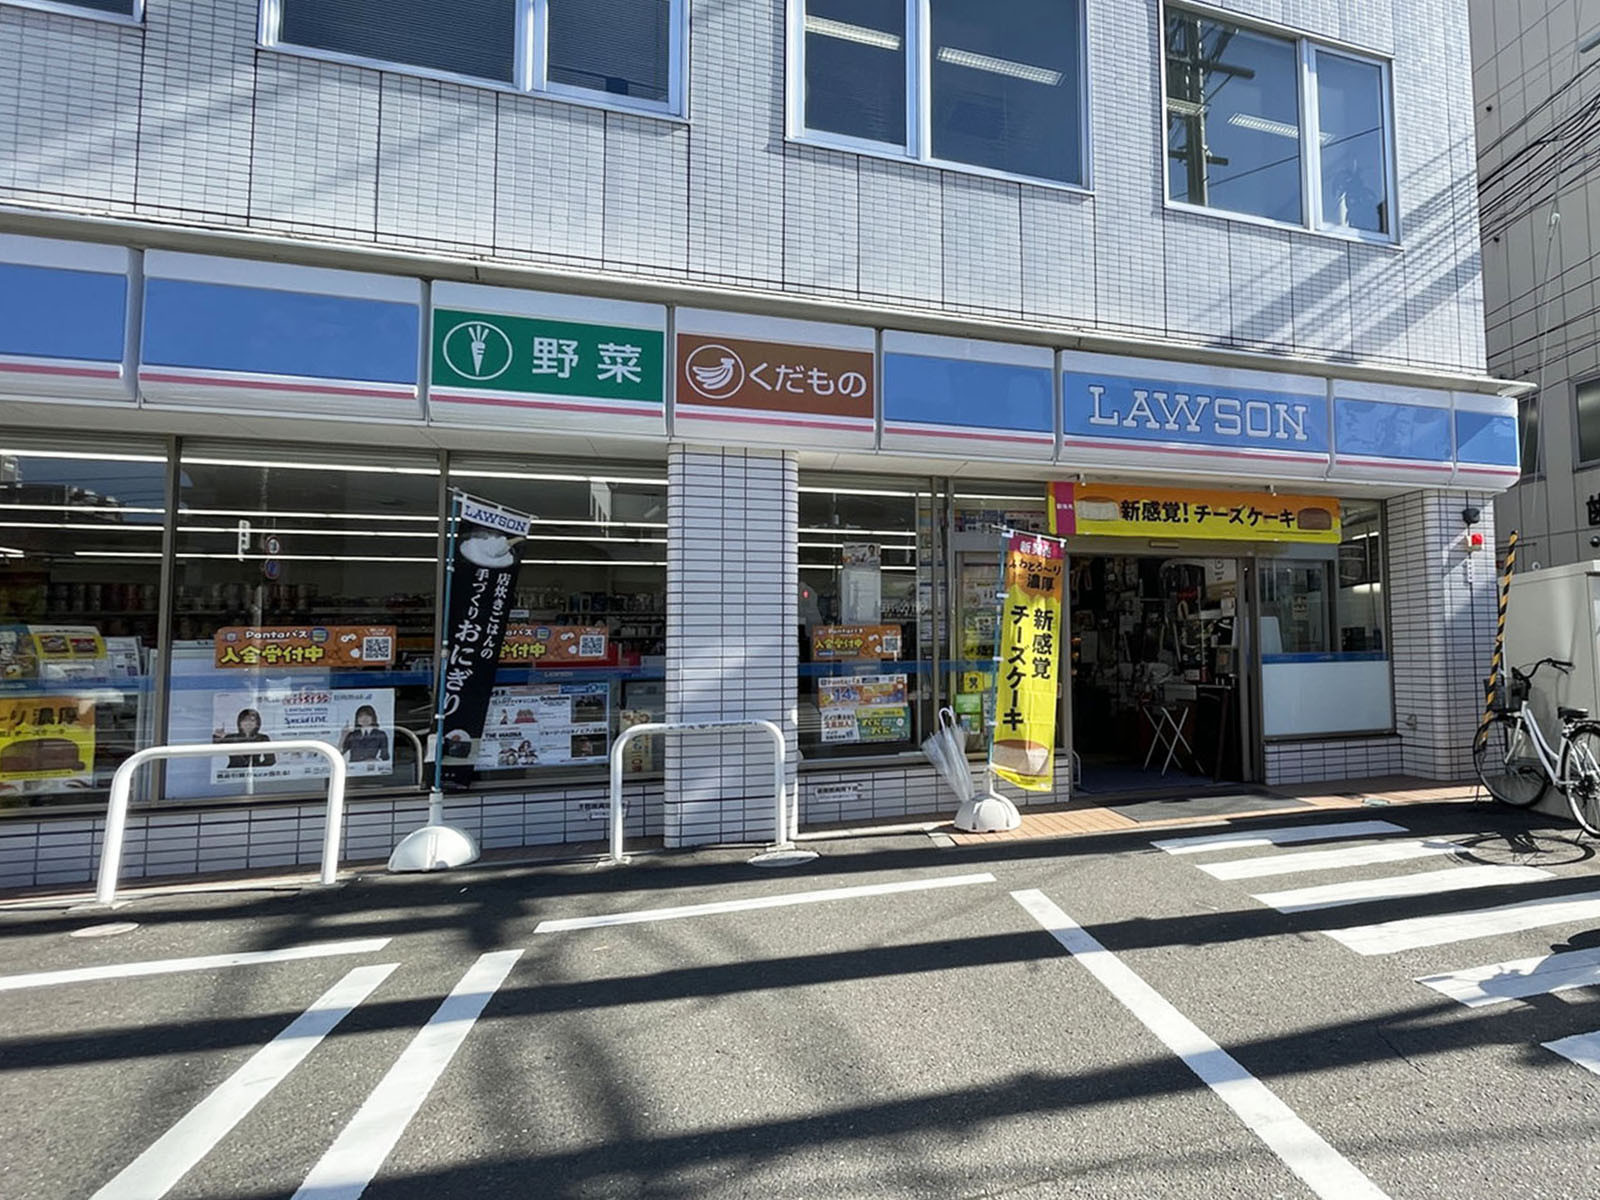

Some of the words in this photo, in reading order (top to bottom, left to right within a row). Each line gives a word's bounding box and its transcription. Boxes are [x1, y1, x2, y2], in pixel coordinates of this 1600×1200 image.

[532, 336, 643, 384] 野菜
[749, 361, 867, 398] くだもの
[1088, 385, 1309, 441] LAWSON
[464, 504, 527, 533] LAWSON
[480, 572, 512, 660] 店炊きごはんの
[221, 645, 323, 664] 入会受付中
[1003, 605, 1030, 731] チーズケーキ
[1032, 608, 1054, 680] 新感覚
